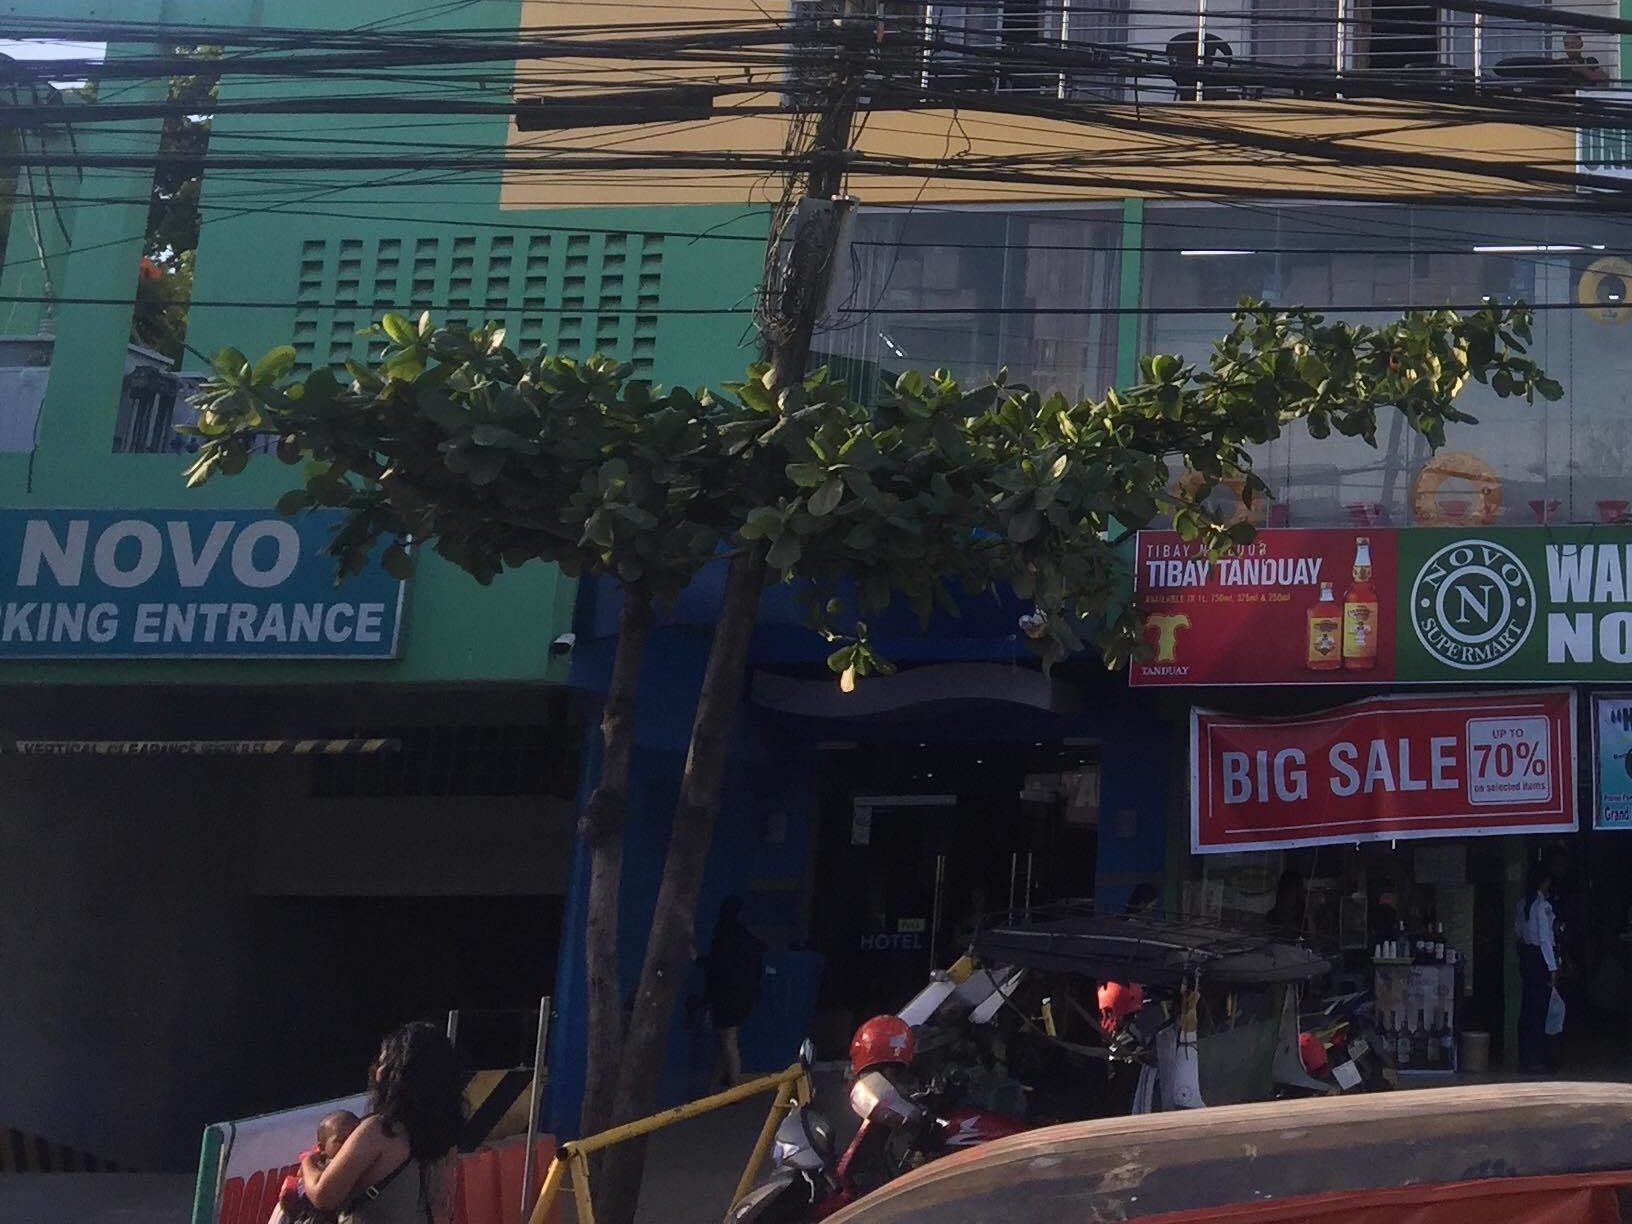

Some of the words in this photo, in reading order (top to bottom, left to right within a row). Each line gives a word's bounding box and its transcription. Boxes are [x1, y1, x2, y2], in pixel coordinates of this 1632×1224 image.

[16, 519, 301, 588] NOVO
[1147, 544, 1191, 558] TIBAY
[1421, 546, 1523, 591] NOVO
[1146, 558, 1210, 588] TIBAY
[1217, 558, 1323, 586] TANDUAY
[1454, 584, 1494, 623] N
[0, 602, 121, 643] KING
[133, 602, 385, 644] ENTRANCE
[1421, 617, 1523, 663] SUPERMART
[1142, 666, 1190, 676] TANDUAY
[1492, 729, 1507, 739] UP
[1509, 728, 1524, 738] TO
[1221, 748, 1308, 806] BIG
[1328, 736, 1460, 799] SALE
[1473, 741, 1546, 778] 70%
[1604, 805, 1629, 822] Grand
[861, 933, 923, 951] HOTEL
